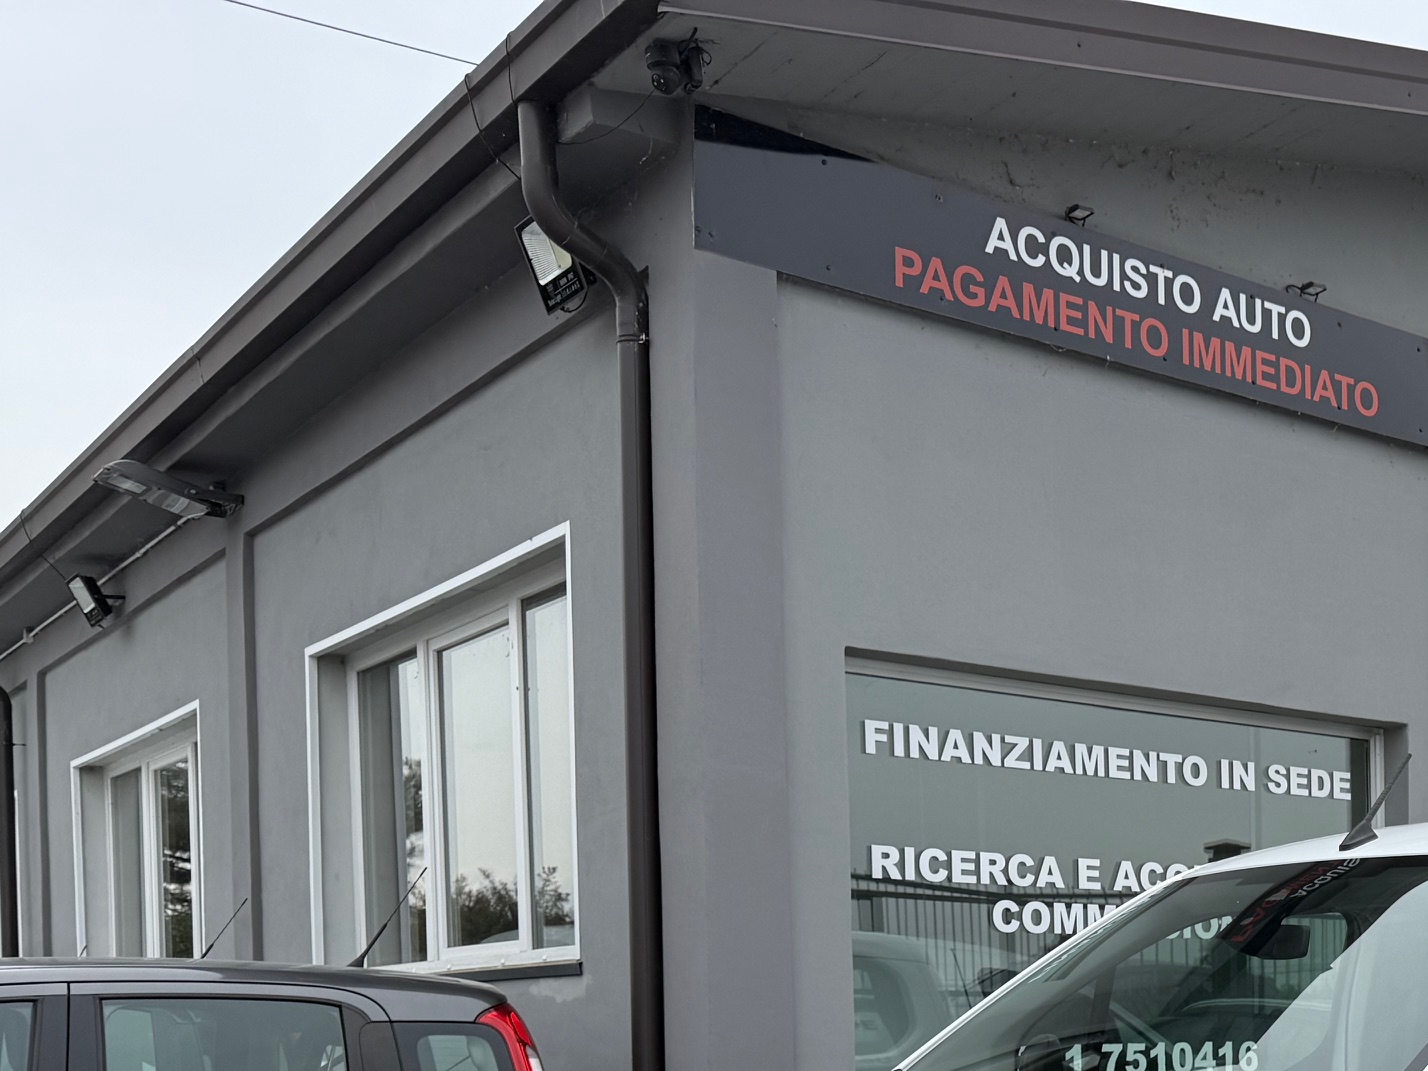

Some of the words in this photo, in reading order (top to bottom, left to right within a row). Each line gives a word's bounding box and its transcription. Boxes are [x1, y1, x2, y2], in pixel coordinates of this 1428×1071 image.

[894, 246, 1170, 358] PAGAMENTO
[1181, 327, 1381, 417] IMMEDIATO
[984, 216, 1202, 315] ACQUISTO
[1212, 287, 1312, 348] AUTO
[864, 719, 1208, 788] FINANZIAMENTO
[1220, 759, 1256, 792] IN
[1267, 765, 1352, 800] SEDE
[870, 844, 1065, 890] RICERCA
[1077, 858, 1101, 891] E
